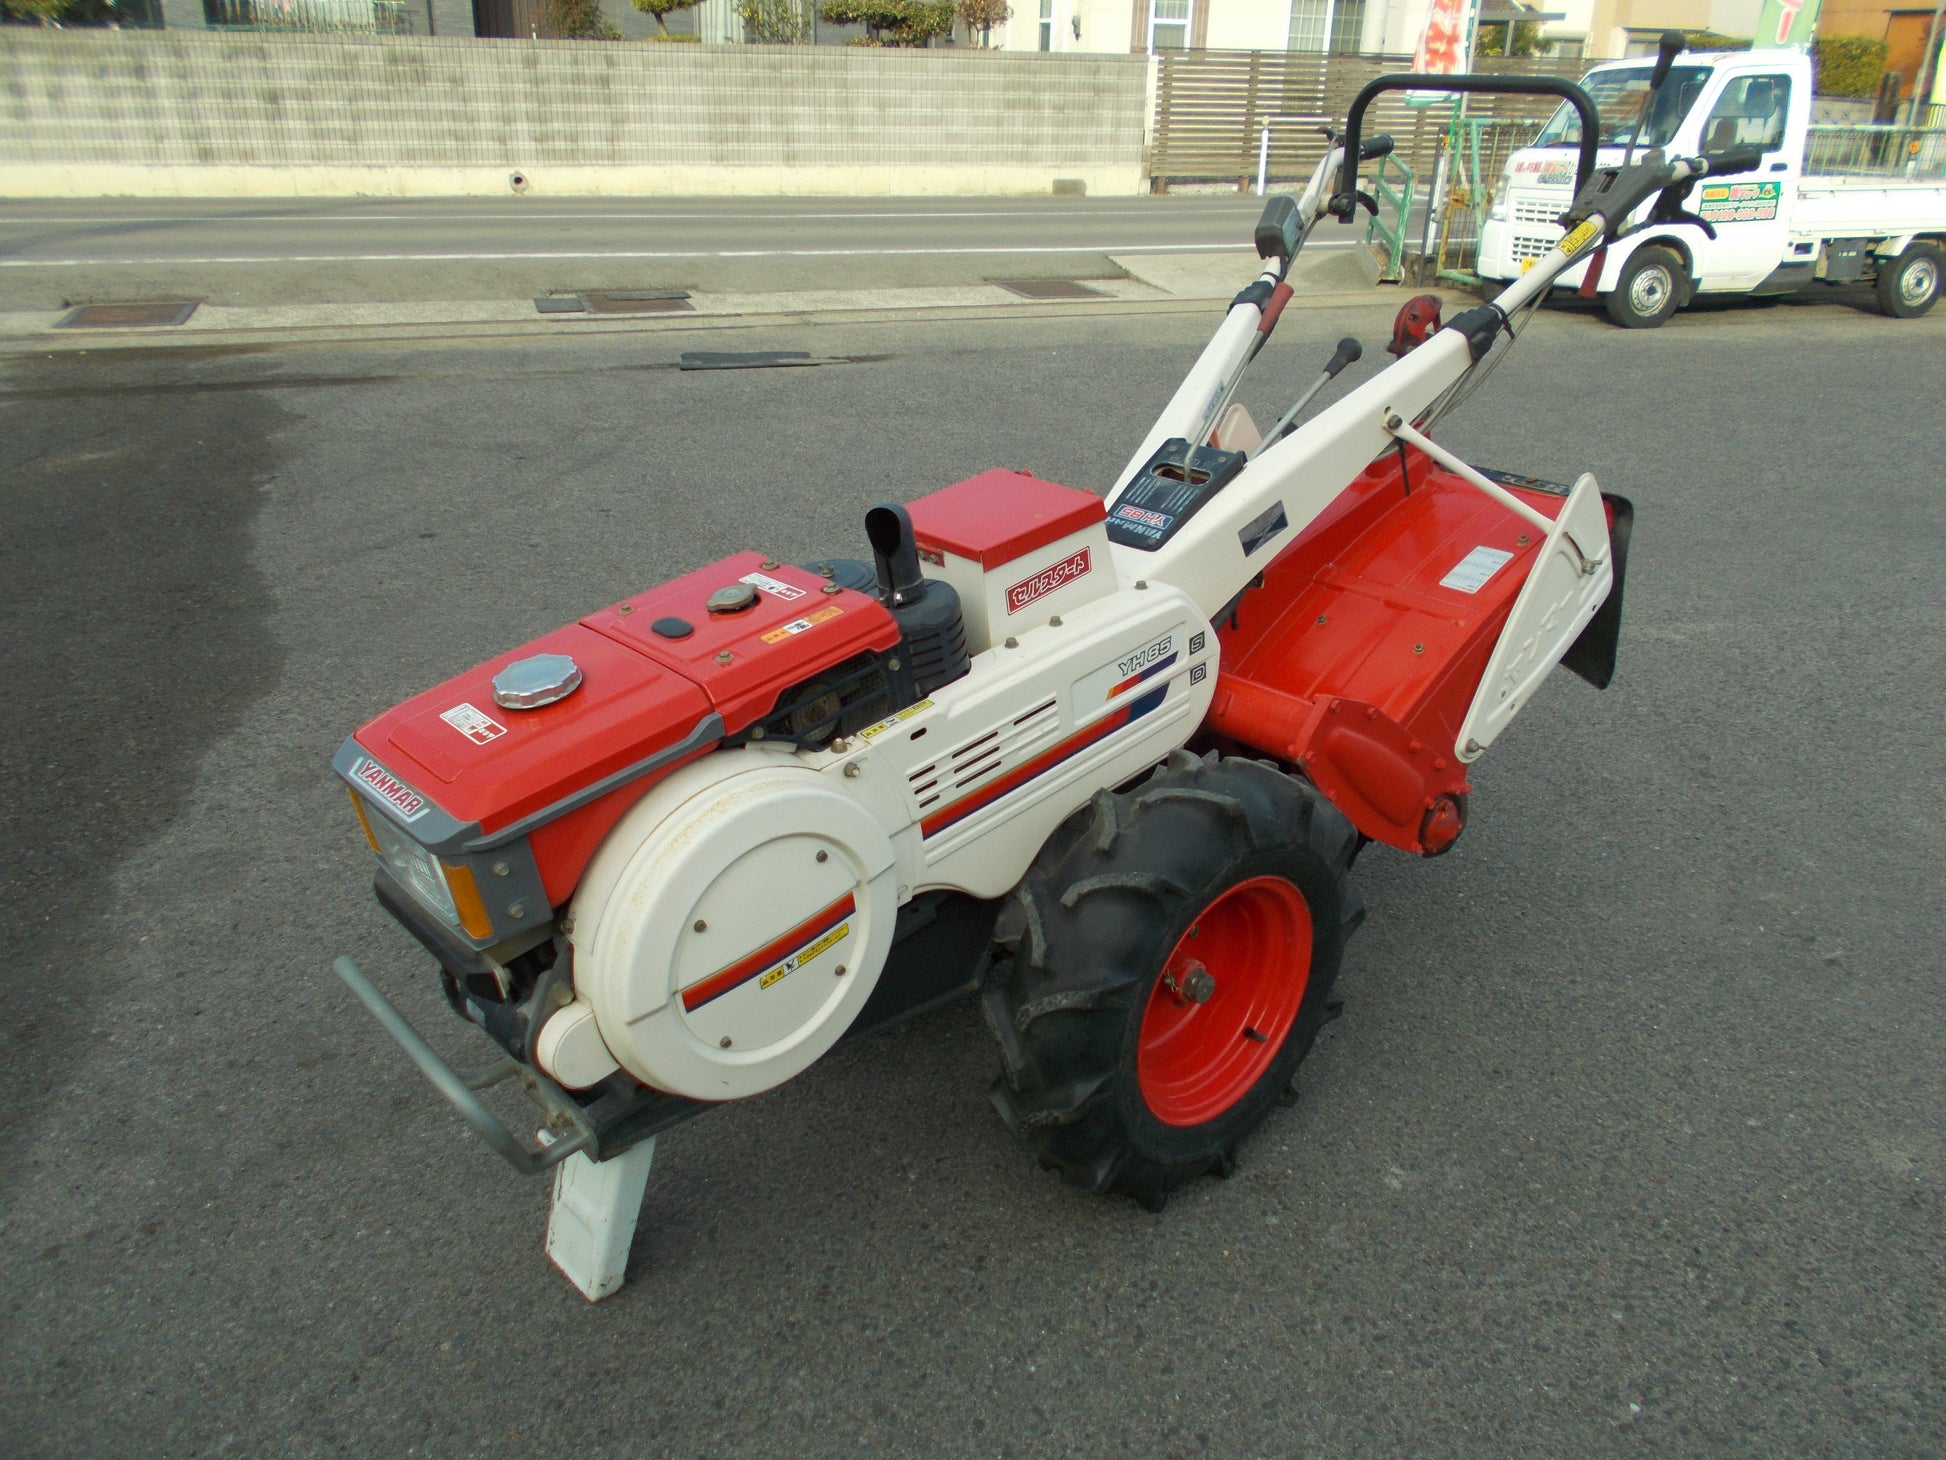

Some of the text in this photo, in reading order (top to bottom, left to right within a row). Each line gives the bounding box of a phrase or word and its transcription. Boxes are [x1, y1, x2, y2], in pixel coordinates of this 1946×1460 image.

[1106, 516, 1163, 540] YANMAR
[1013, 556, 1085, 606] セルスタート
[1191, 635, 1204, 653] S
[1191, 664, 1206, 684] D
[358, 760, 424, 815] YANMAR
